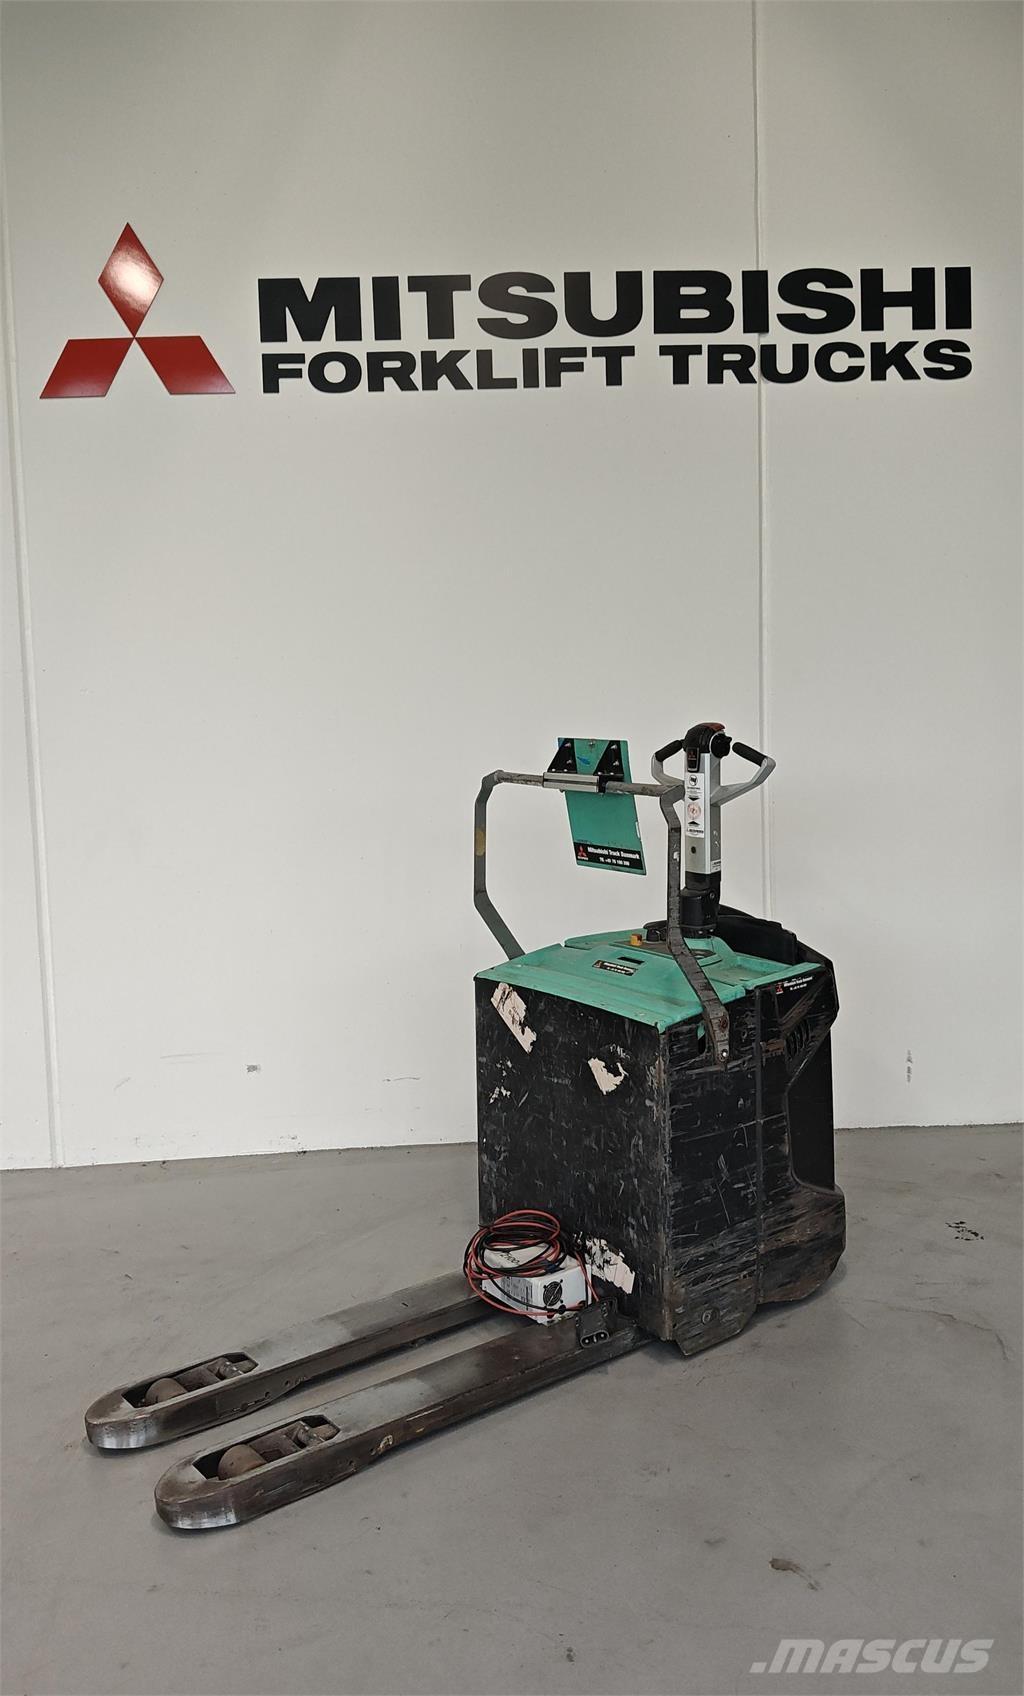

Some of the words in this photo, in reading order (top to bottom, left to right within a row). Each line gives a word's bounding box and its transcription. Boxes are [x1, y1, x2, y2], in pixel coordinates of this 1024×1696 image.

[257, 266, 972, 343] MITSUBISHI
[261, 345, 636, 394] FORKLIFT
[658, 339, 973, 385] TRUCKS
